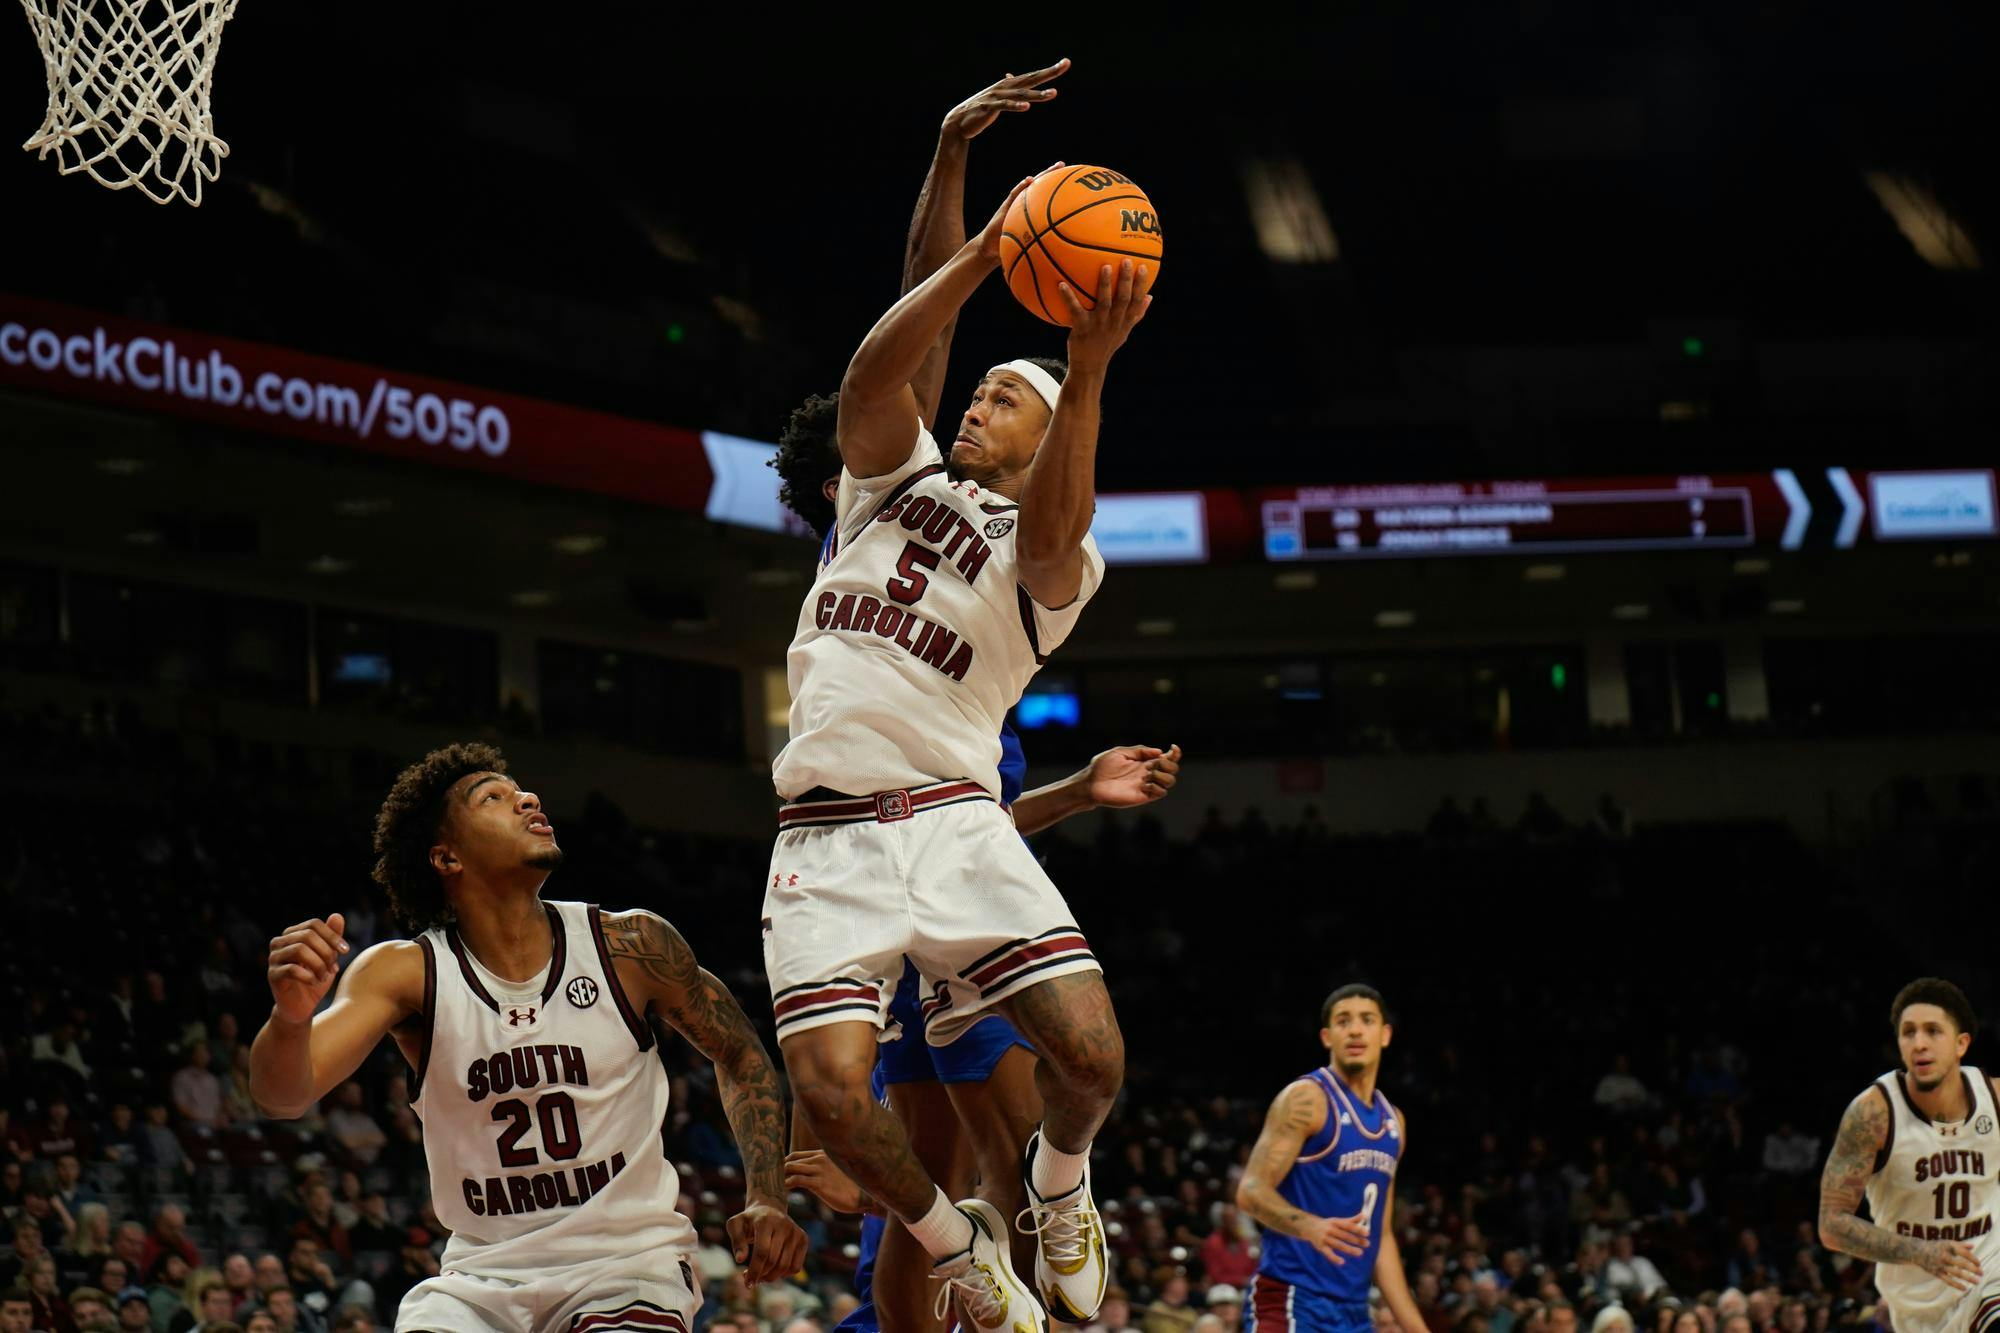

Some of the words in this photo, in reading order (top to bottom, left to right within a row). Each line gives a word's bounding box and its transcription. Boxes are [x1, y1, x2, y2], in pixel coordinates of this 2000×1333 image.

[0, 322, 511, 456] cockClub.com/5050
[877, 493, 992, 586] SOUTH
[886, 539, 941, 606] 5
[815, 591, 974, 682] CAROLINA
[568, 978, 598, 1007] SEC
[467, 1044, 589, 1103] SOUTH
[490, 1091, 582, 1168] 20
[1914, 1150, 1985, 1182] SOUTH
[1896, 1212, 1993, 1242] CAROLINA
[1932, 1181, 1970, 1219] 10
